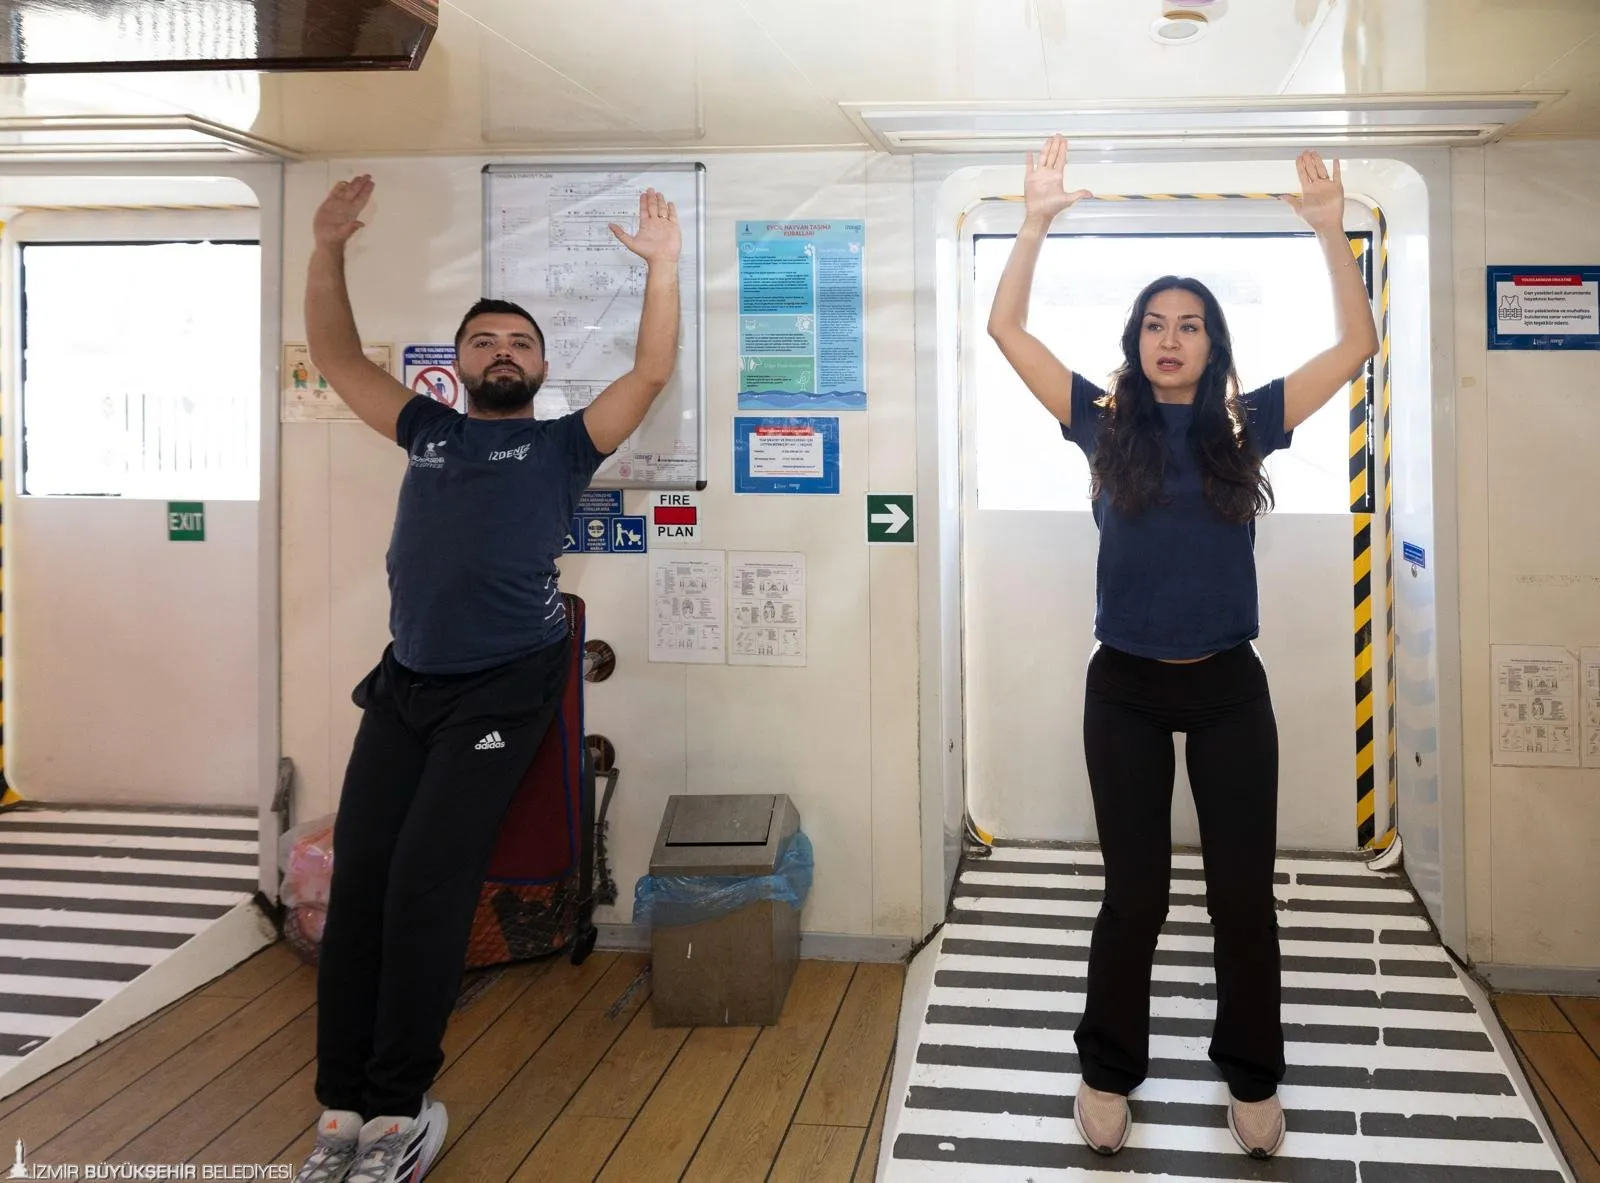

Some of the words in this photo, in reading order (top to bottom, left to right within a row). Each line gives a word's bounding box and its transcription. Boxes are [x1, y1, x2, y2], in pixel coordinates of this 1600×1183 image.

[660, 495, 690, 505] FIRE
[169, 512, 203, 530] EXIT
[658, 527, 694, 537] PLAN
[474, 741, 505, 750] adidas
